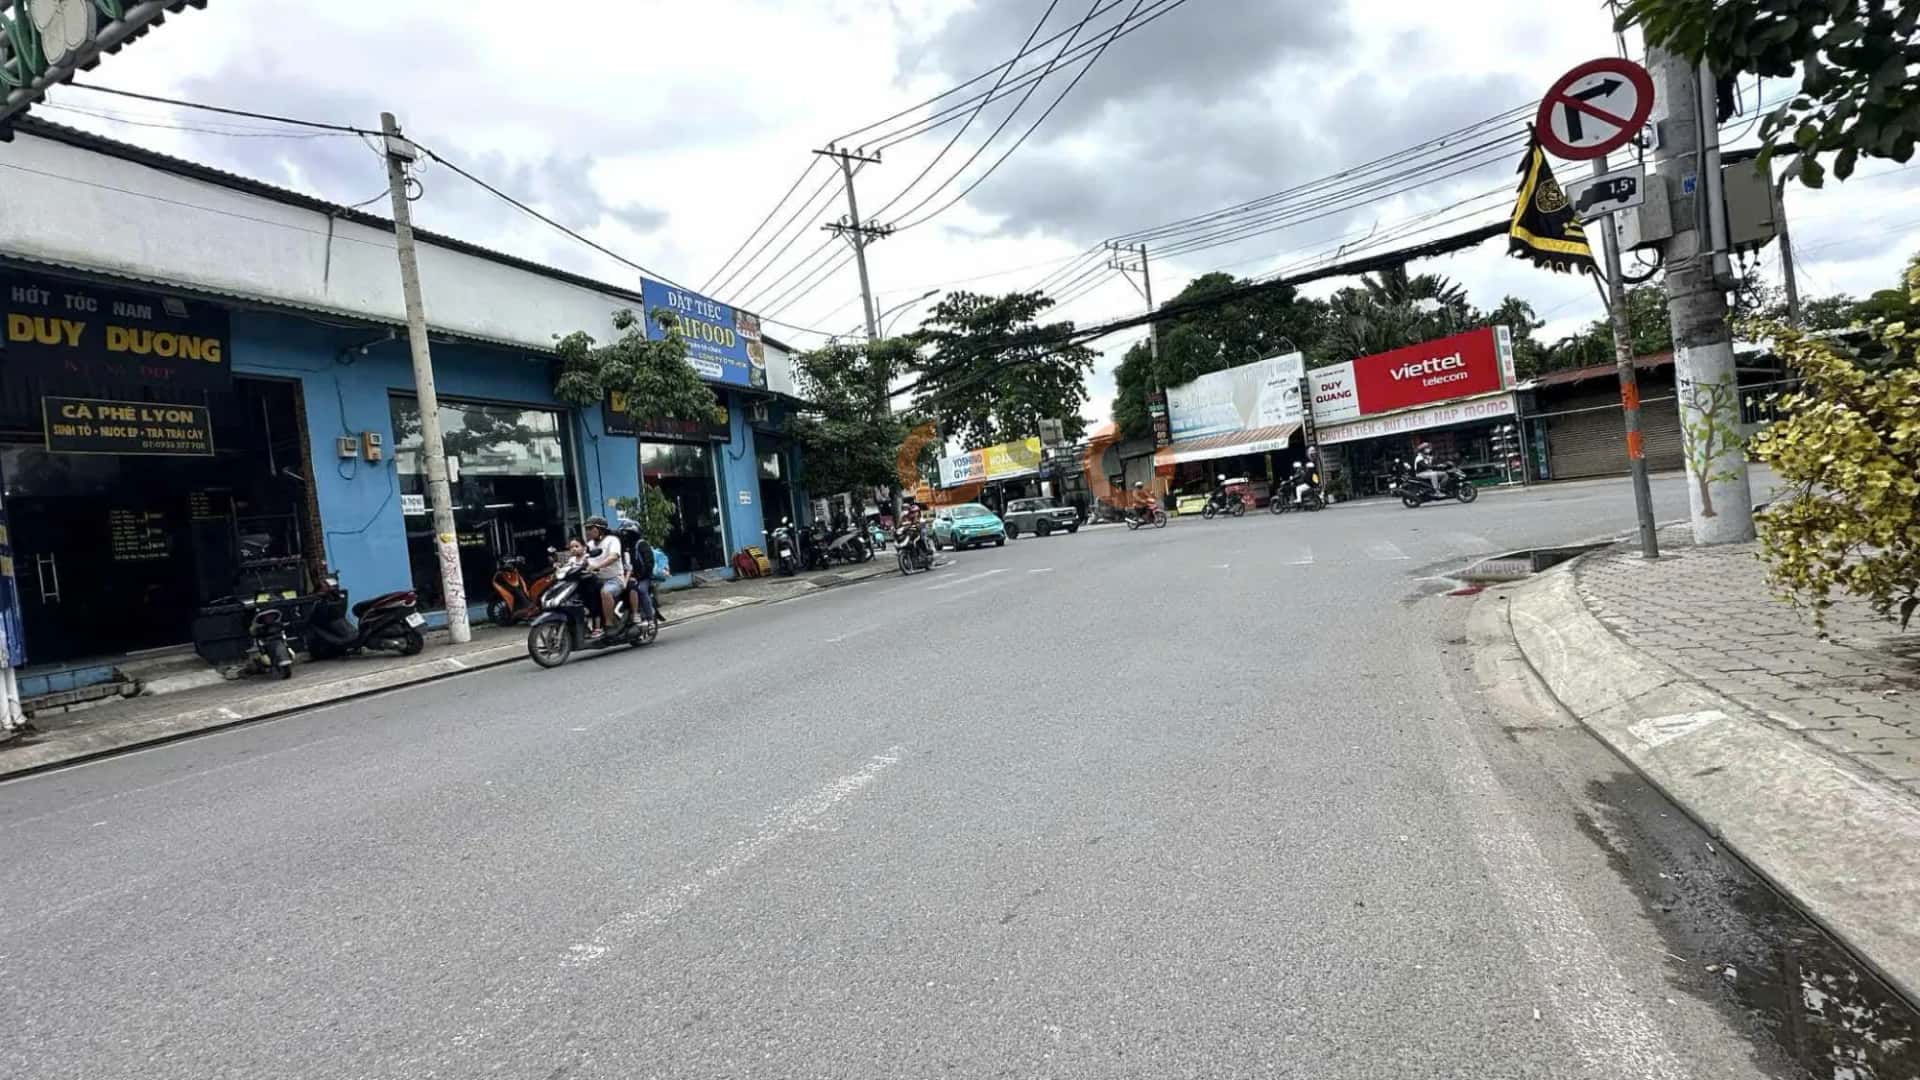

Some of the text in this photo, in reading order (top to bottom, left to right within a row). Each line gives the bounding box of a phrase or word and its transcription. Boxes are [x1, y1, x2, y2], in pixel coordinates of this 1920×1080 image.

[113, 301, 152, 320] NAM
[667, 291, 722, 322] ĐẶT TIỆC
[8, 313, 86, 347] DUY
[1390, 352, 1466, 380] viettel
[1321, 380, 1342, 392] DUY
[1423, 371, 1468, 387] telecom
[1316, 390, 1352, 404] QUANG
[141, 409, 194, 424] LYON
